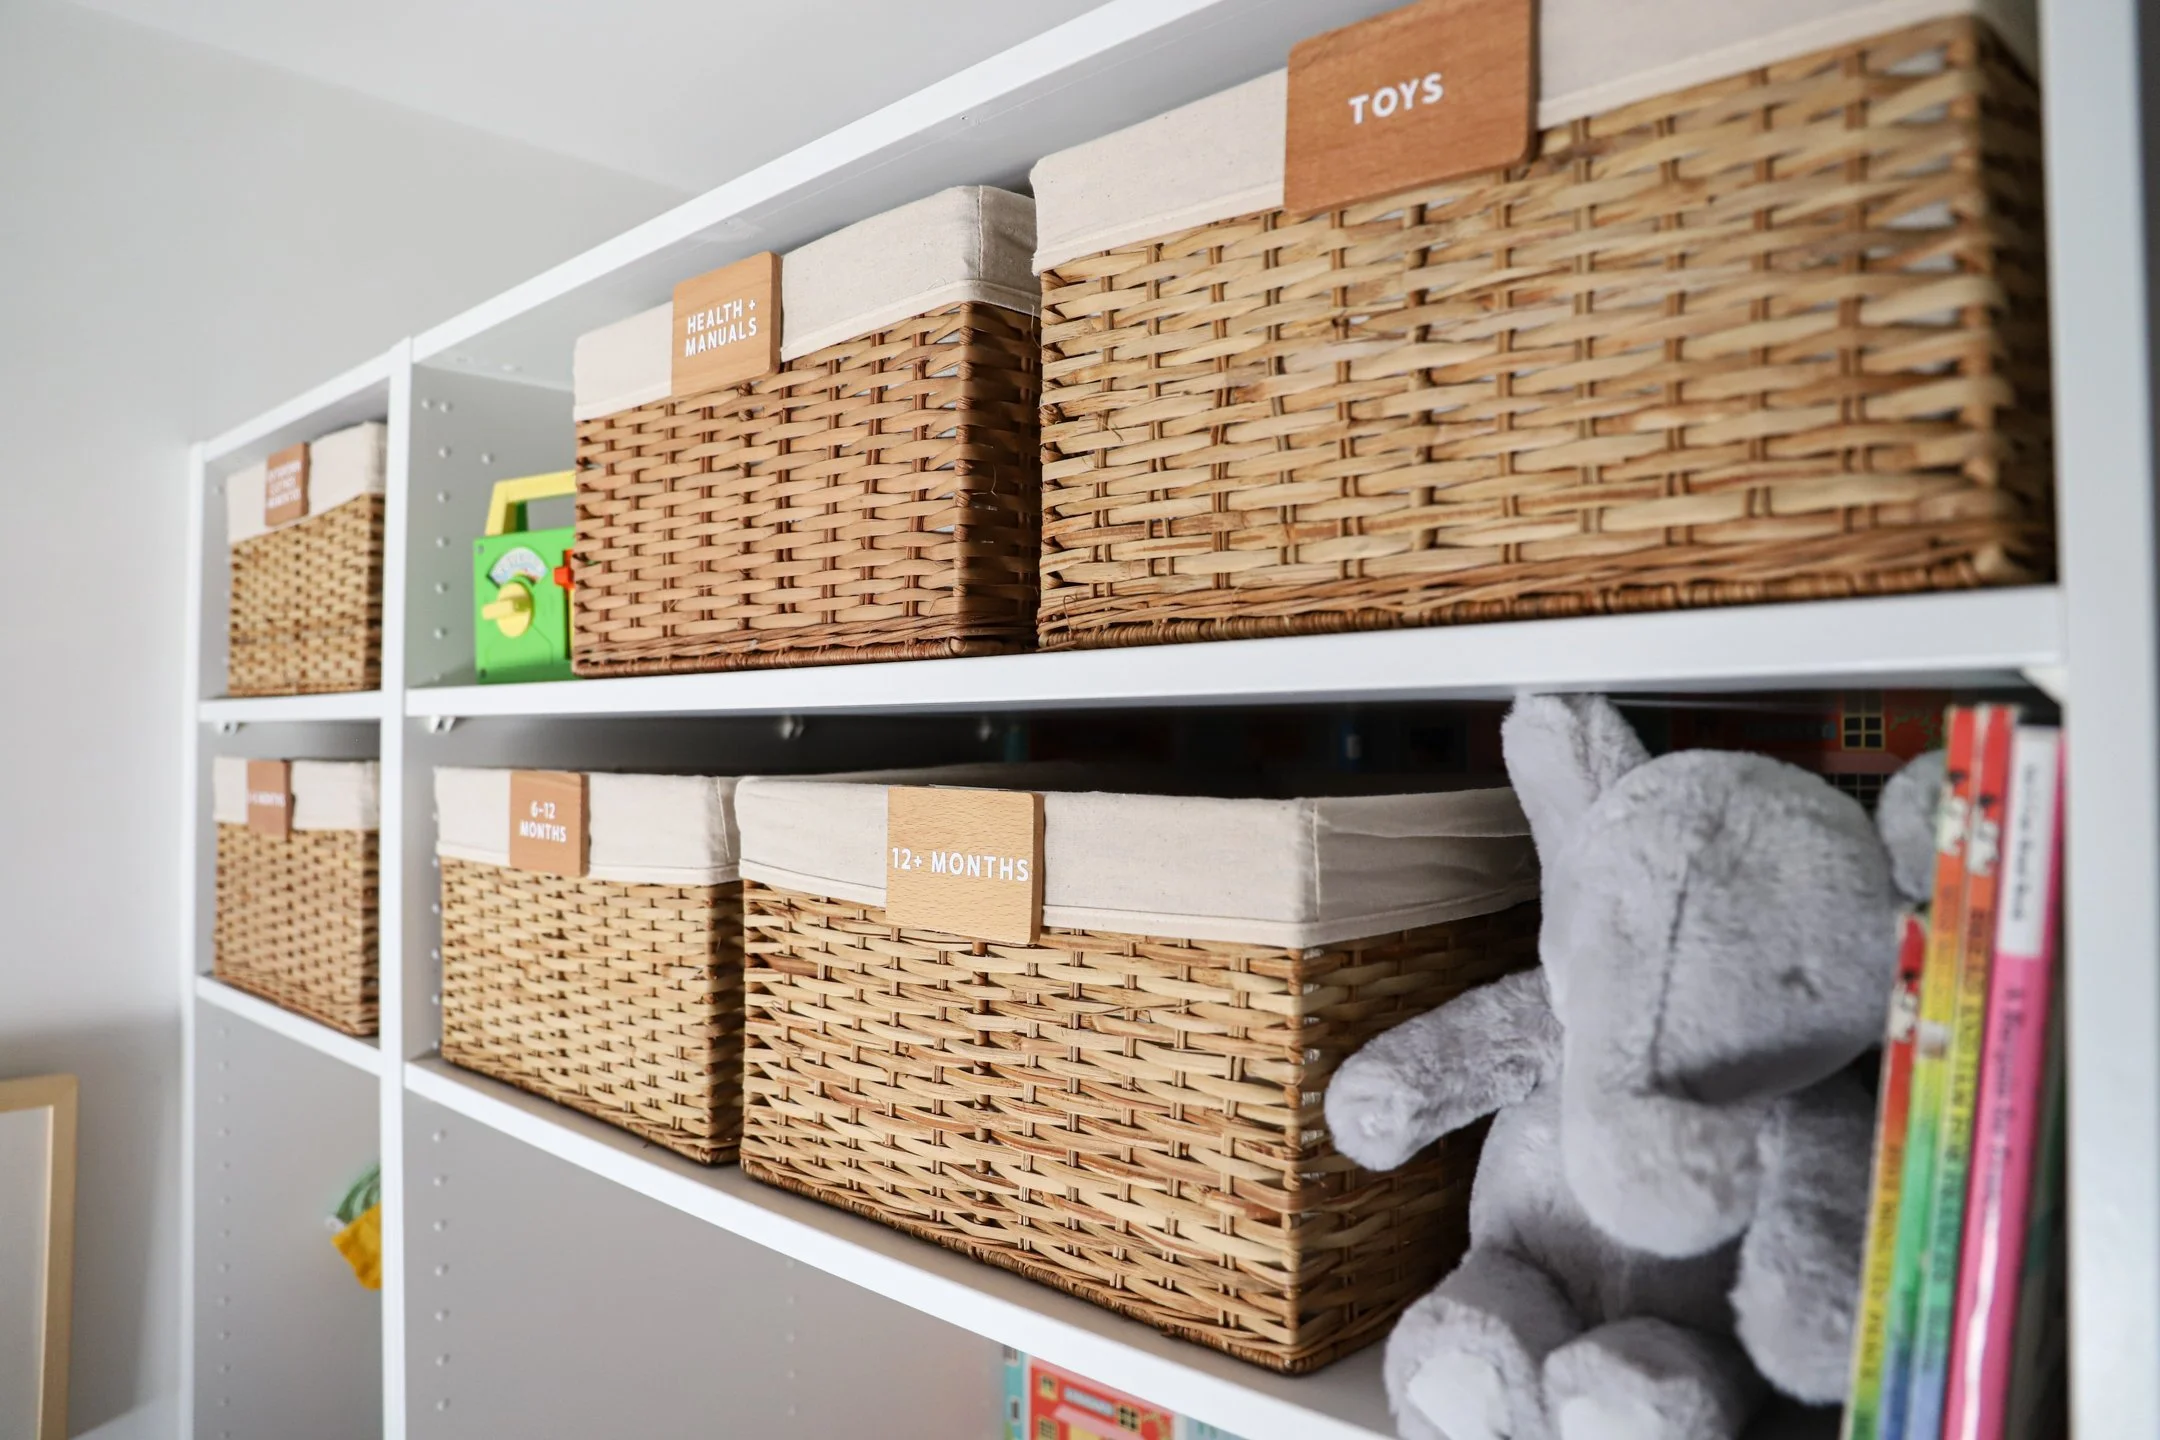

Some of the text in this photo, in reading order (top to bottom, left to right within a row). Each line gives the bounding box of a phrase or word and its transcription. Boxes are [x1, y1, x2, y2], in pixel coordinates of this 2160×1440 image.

[1347, 71, 1444, 125] TOYS
[686, 298, 757, 335] HEALTH +
[684, 316, 758, 358] MANUALS
[529, 800, 557, 820] 6-12
[518, 820, 568, 843] MONTHS
[891, 847, 1030, 882] 12+ MONTHS
